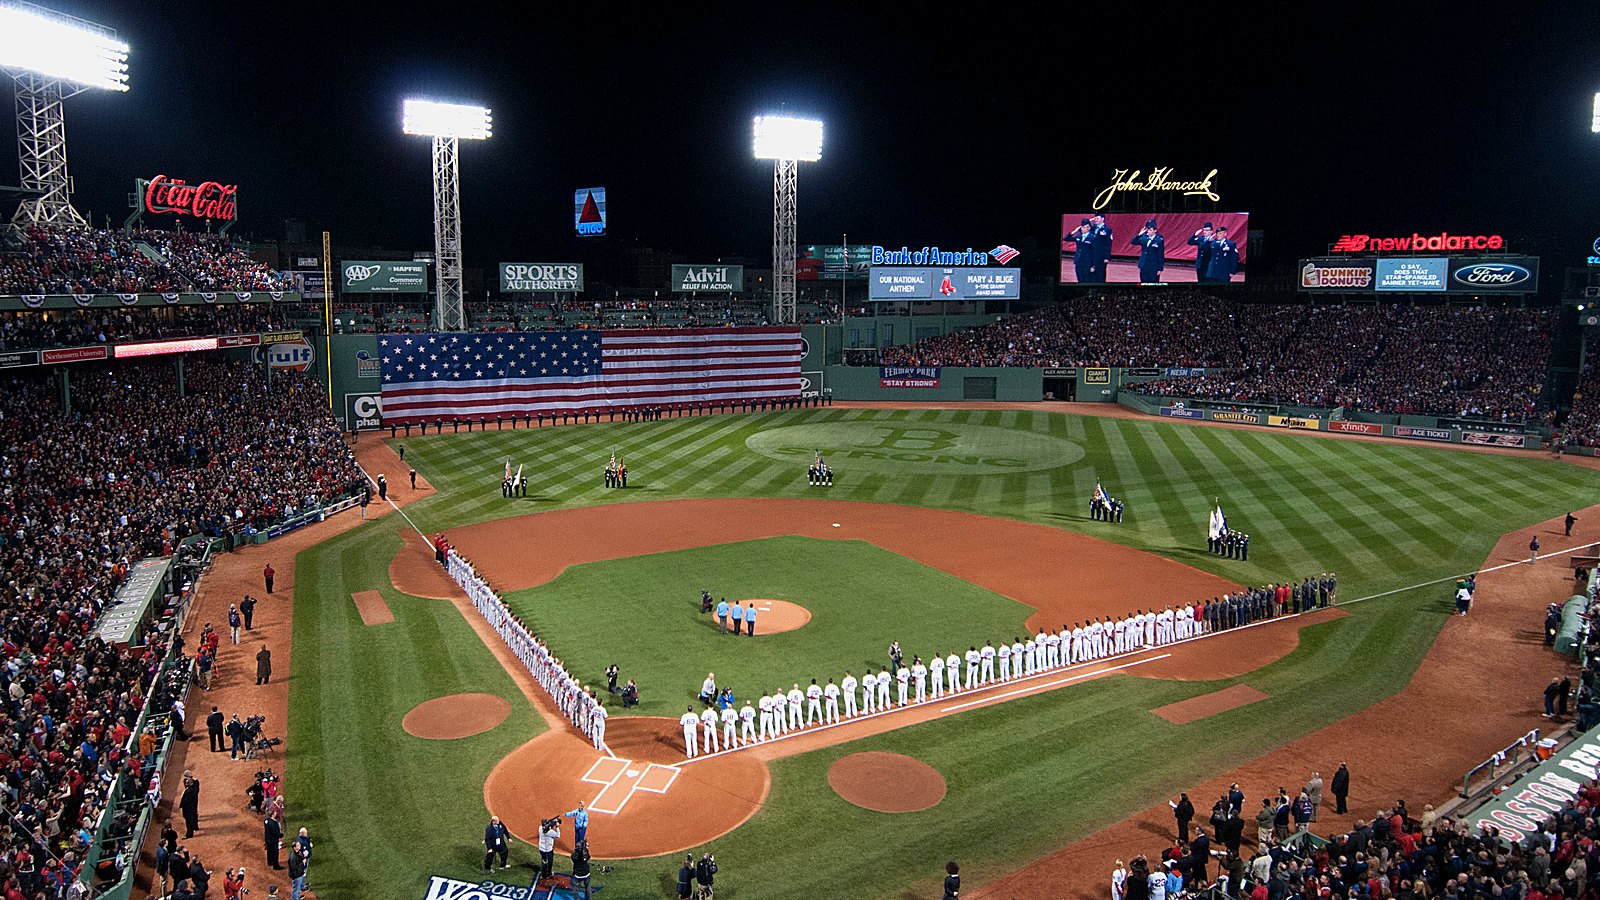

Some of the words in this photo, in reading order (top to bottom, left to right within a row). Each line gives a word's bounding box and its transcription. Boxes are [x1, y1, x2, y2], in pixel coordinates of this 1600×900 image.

[1093, 168, 1143, 210] John
[1143, 167, 1220, 202] Hancock
[145, 174, 238, 220] Coca-Cola
[578, 223, 603, 234] CITGO
[1370, 237, 1412, 250] new
[1413, 232, 1503, 250] balance
[872, 246, 912, 265] Bank
[913, 247, 930, 265] of
[930, 247, 988, 265] America
[348, 267, 367, 277] AAA
[505, 265, 578, 280] SPORTS
[683, 267, 727, 282] Advil
[1322, 269, 1371, 277] DUNKIN'
[1467, 266, 1515, 283] Ford
[968, 275, 986, 283] MARY
[988, 275, 994, 283] J.
[995, 275, 1014, 283] BLIGE
[1322, 277, 1368, 285] DONUTS
[507, 281, 578, 290] AUTHORITY
[45, 351, 79, 361] Northeastern
[79, 349, 105, 357] University
[257, 349, 310, 362] Gulf
[885, 367, 914, 378] FENWAY
[916, 367, 937, 378] PARK
[354, 396, 383, 418] CV
[1213, 412, 1242, 421] GRANITE
[1280, 417, 1306, 427] Nikon
[1340, 422, 1370, 433] xfinity
[1426, 430, 1449, 438] TICKET
[1476, 772, 1581, 843] BOSTON
[1154, 878, 1166, 888] 23
[478, 881, 528, 900] 2013
